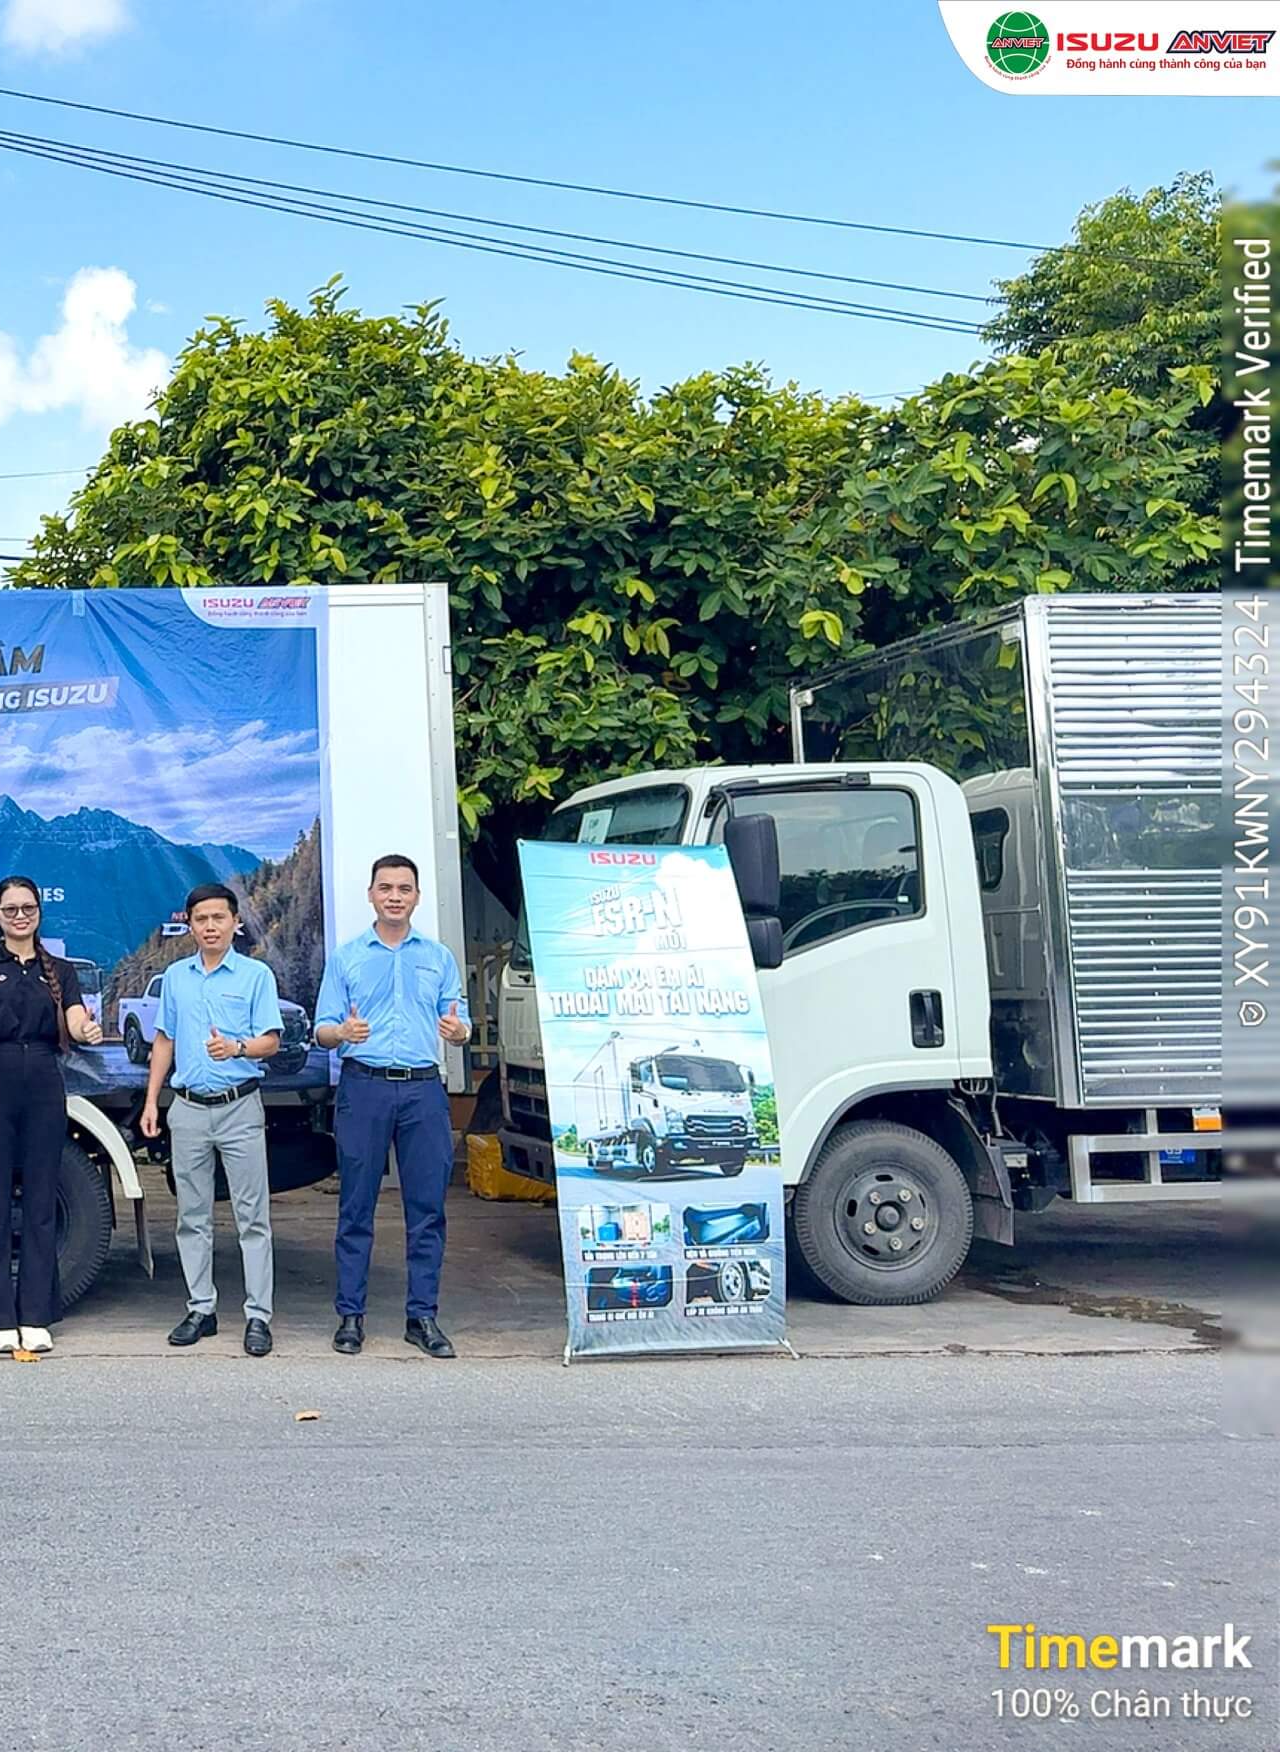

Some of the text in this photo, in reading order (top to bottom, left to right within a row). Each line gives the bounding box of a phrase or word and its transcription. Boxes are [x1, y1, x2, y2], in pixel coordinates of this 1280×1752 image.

[203, 598, 254, 608] ISUZU
[26, 682, 108, 709] ISUZU
[590, 852, 656, 865] ISUZU
